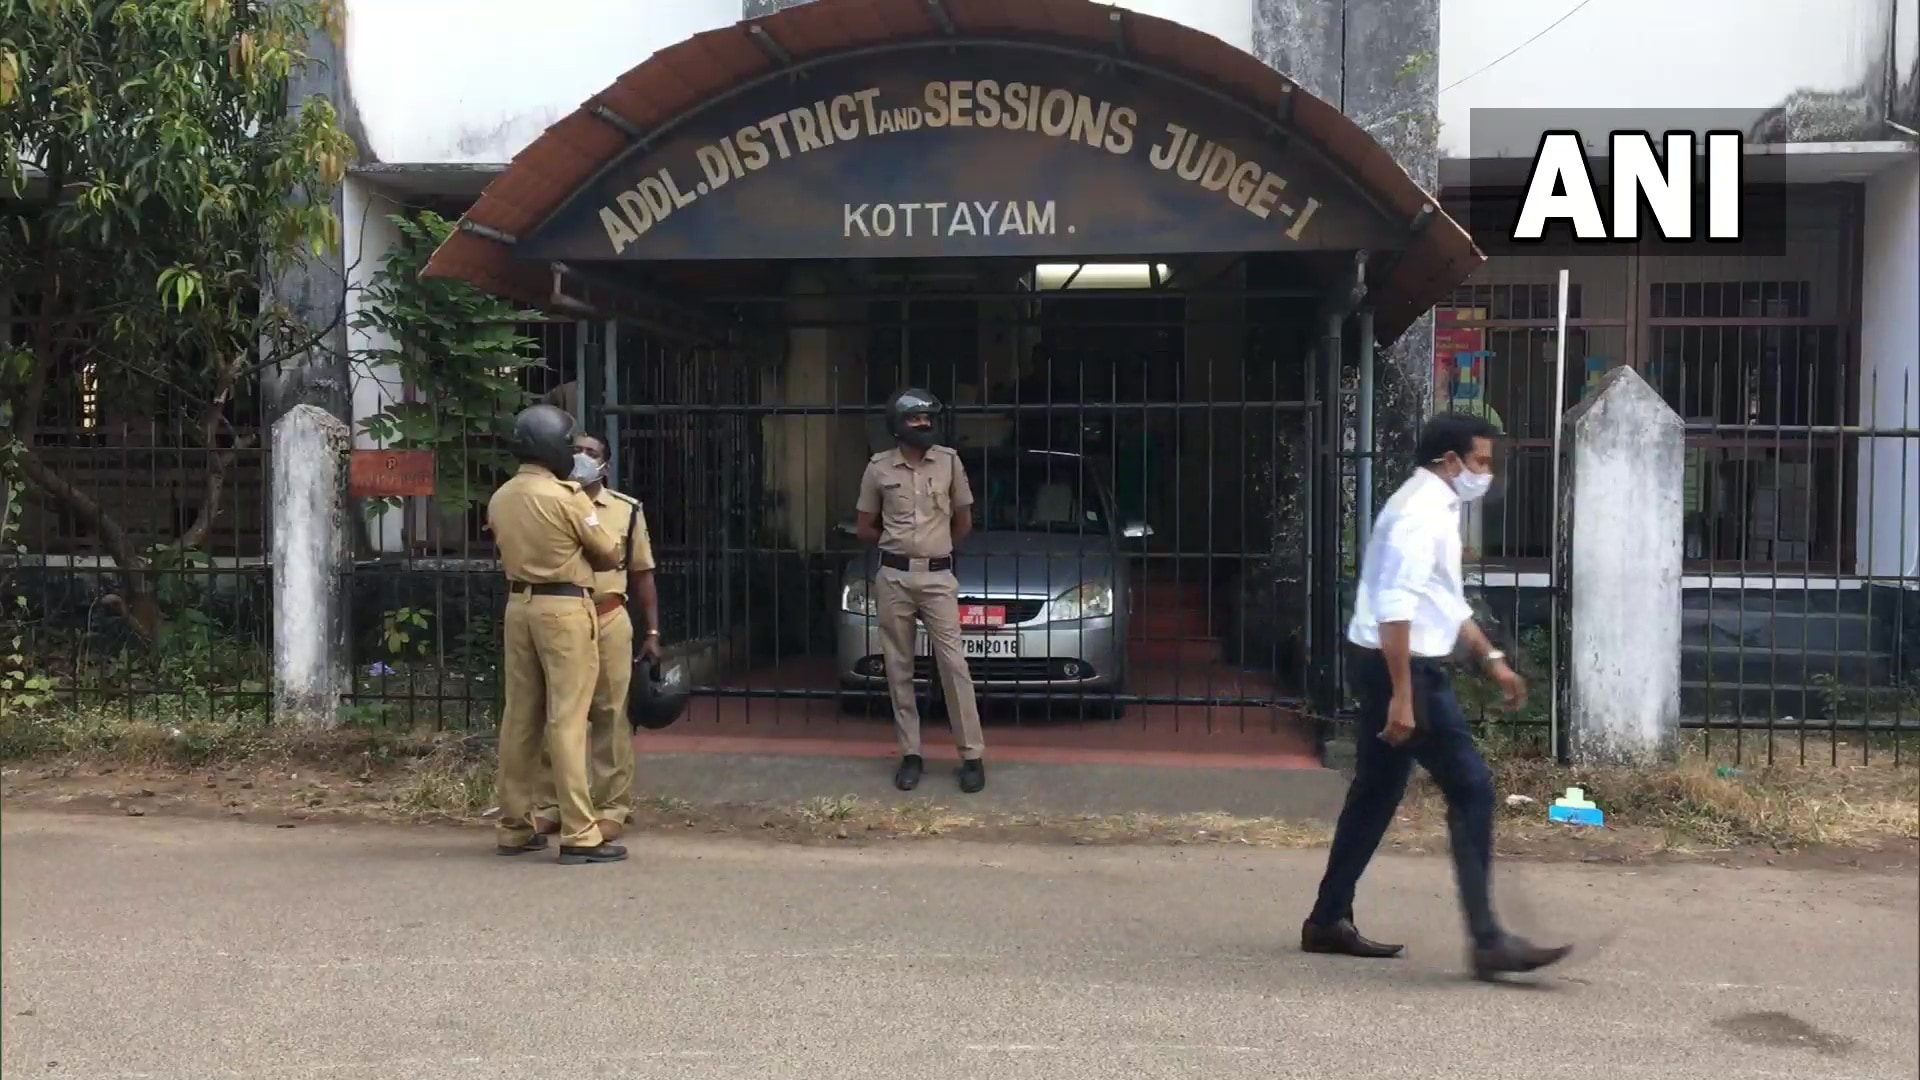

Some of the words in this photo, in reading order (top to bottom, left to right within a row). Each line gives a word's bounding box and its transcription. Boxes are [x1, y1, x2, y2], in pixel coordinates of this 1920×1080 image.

[696, 87, 881, 189] DISTRICT
[879, 106, 923, 133] AND
[924, 79, 1138, 155] SESSIONS
